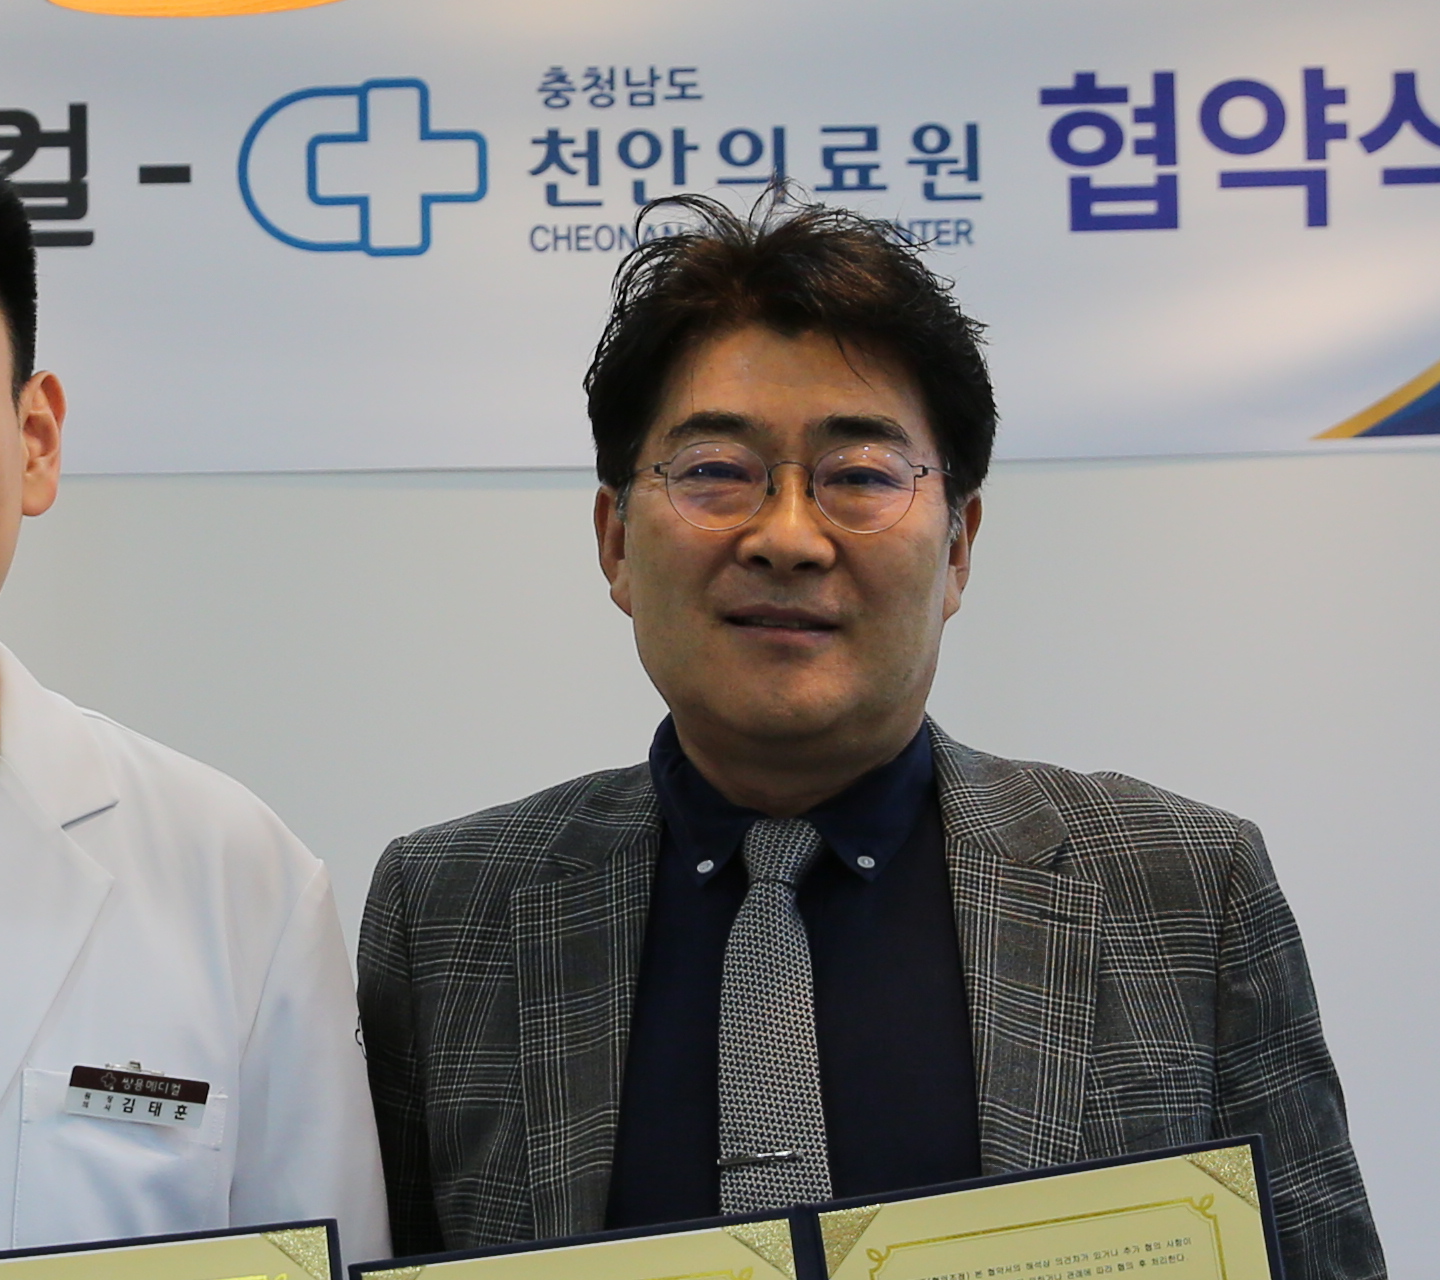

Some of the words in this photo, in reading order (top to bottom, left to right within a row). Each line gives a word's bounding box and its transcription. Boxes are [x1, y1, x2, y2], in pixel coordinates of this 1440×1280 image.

[535, 66, 704, 110] 충청남도
[528, 122, 984, 208] 천안의료원
[121, 1077, 183, 1098] 쌍용메디컬
[122, 1096, 189, 1122] 김태훈
